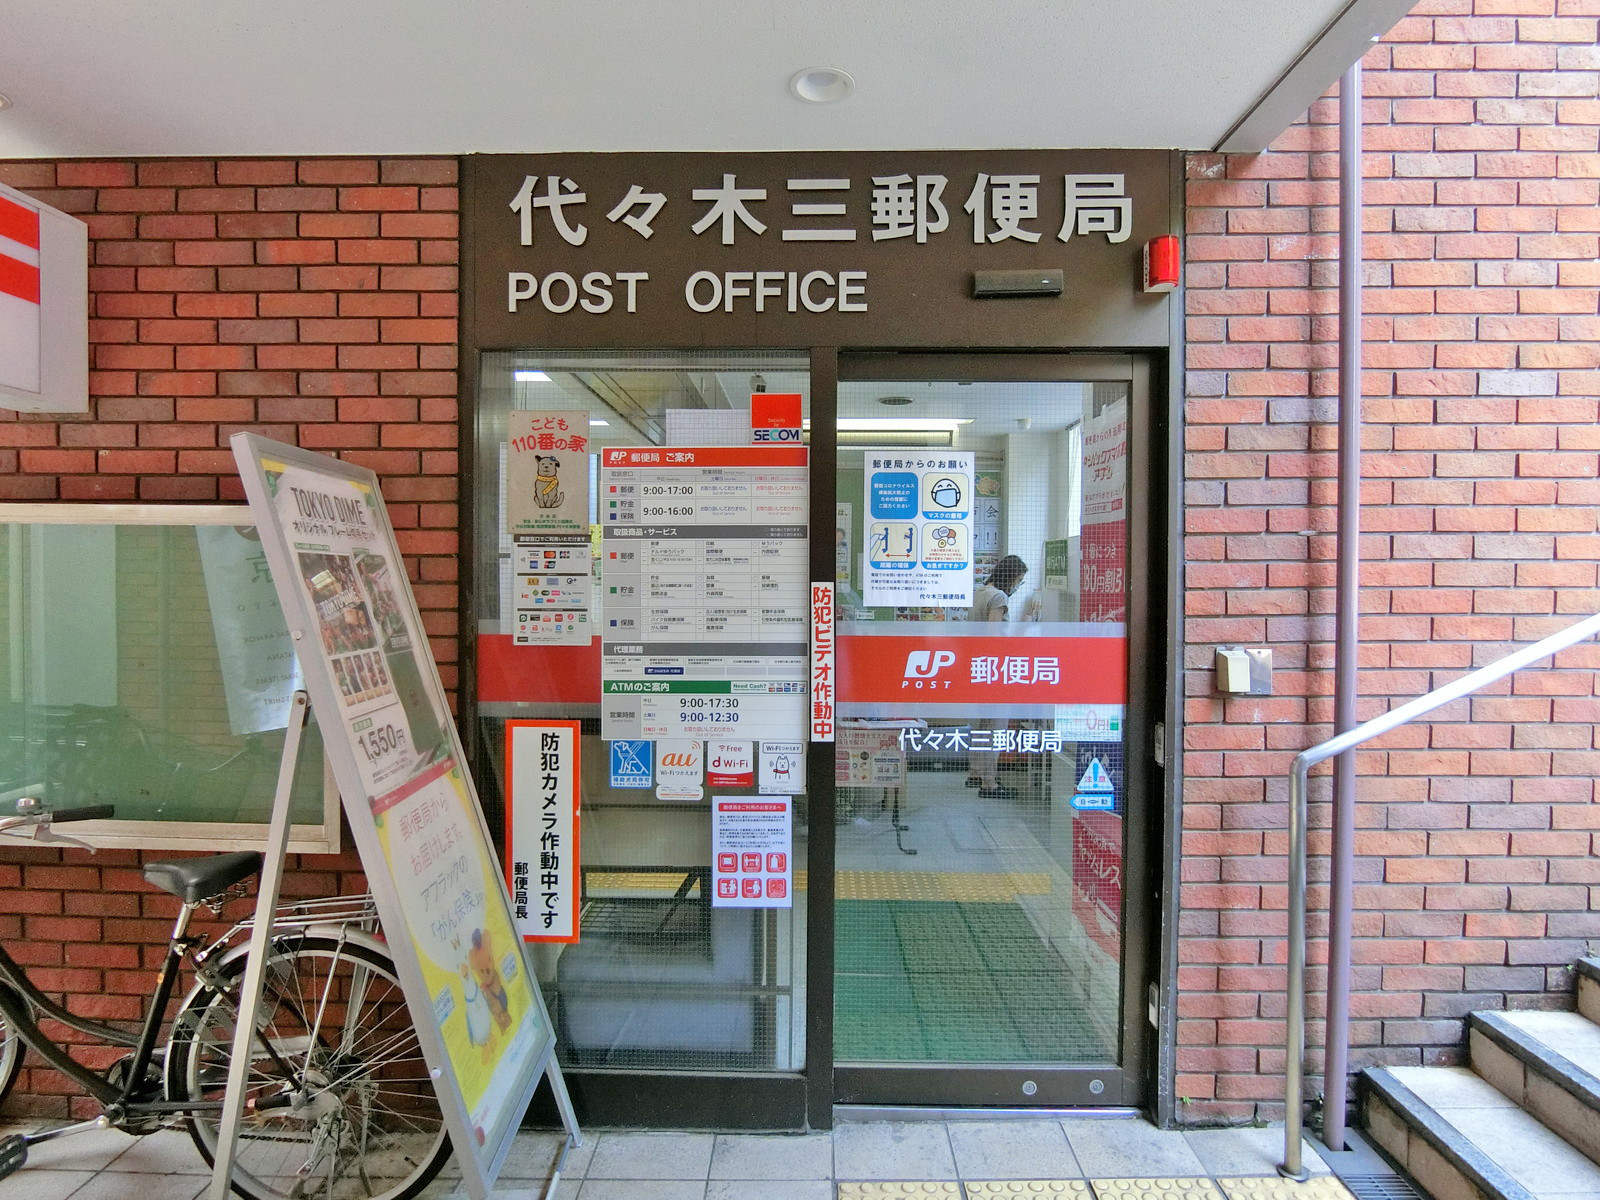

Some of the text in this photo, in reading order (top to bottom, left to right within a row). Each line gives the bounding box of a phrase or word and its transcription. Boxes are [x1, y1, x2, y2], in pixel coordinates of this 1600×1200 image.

[508, 173, 1133, 246] 代々木三郵便局
[508, 271, 868, 314] POST OFFICE
[531, 417, 569, 431] こども
[754, 429, 800, 441] SECOM
[511, 433, 588, 453] 110番の家
[631, 453, 695, 463] 郵便局 ご案内
[872, 459, 968, 469] 郵便局からのお願い
[643, 486, 693, 495] 9:00-17:00
[290, 486, 367, 526] TOKYO DIME
[643, 507, 693, 516] 9:00-16:00
[613, 528, 678, 536] 取扱商品・サービス
[813, 586, 832, 739] 防犯ビデオ作動中
[970, 656, 1060, 685] 郵便局
[610, 682, 670, 692] ATMのご案内
[902, 680, 952, 689] POST
[680, 698, 739, 708] 9:00-17:30
[680, 712, 739, 722] 9:00-12:30
[898, 728, 1063, 754] 代々木三郵便局
[661, 752, 698, 767] au
[712, 756, 749, 768] d Wi-Fi
[398, 792, 449, 842] 郵便局から
[540, 732, 560, 929] 防犯カメラ作動中です
[410, 822, 463, 877] お届けします。
[420, 855, 469, 913] アフラックの
[514, 861, 529, 919] 郵便局長
